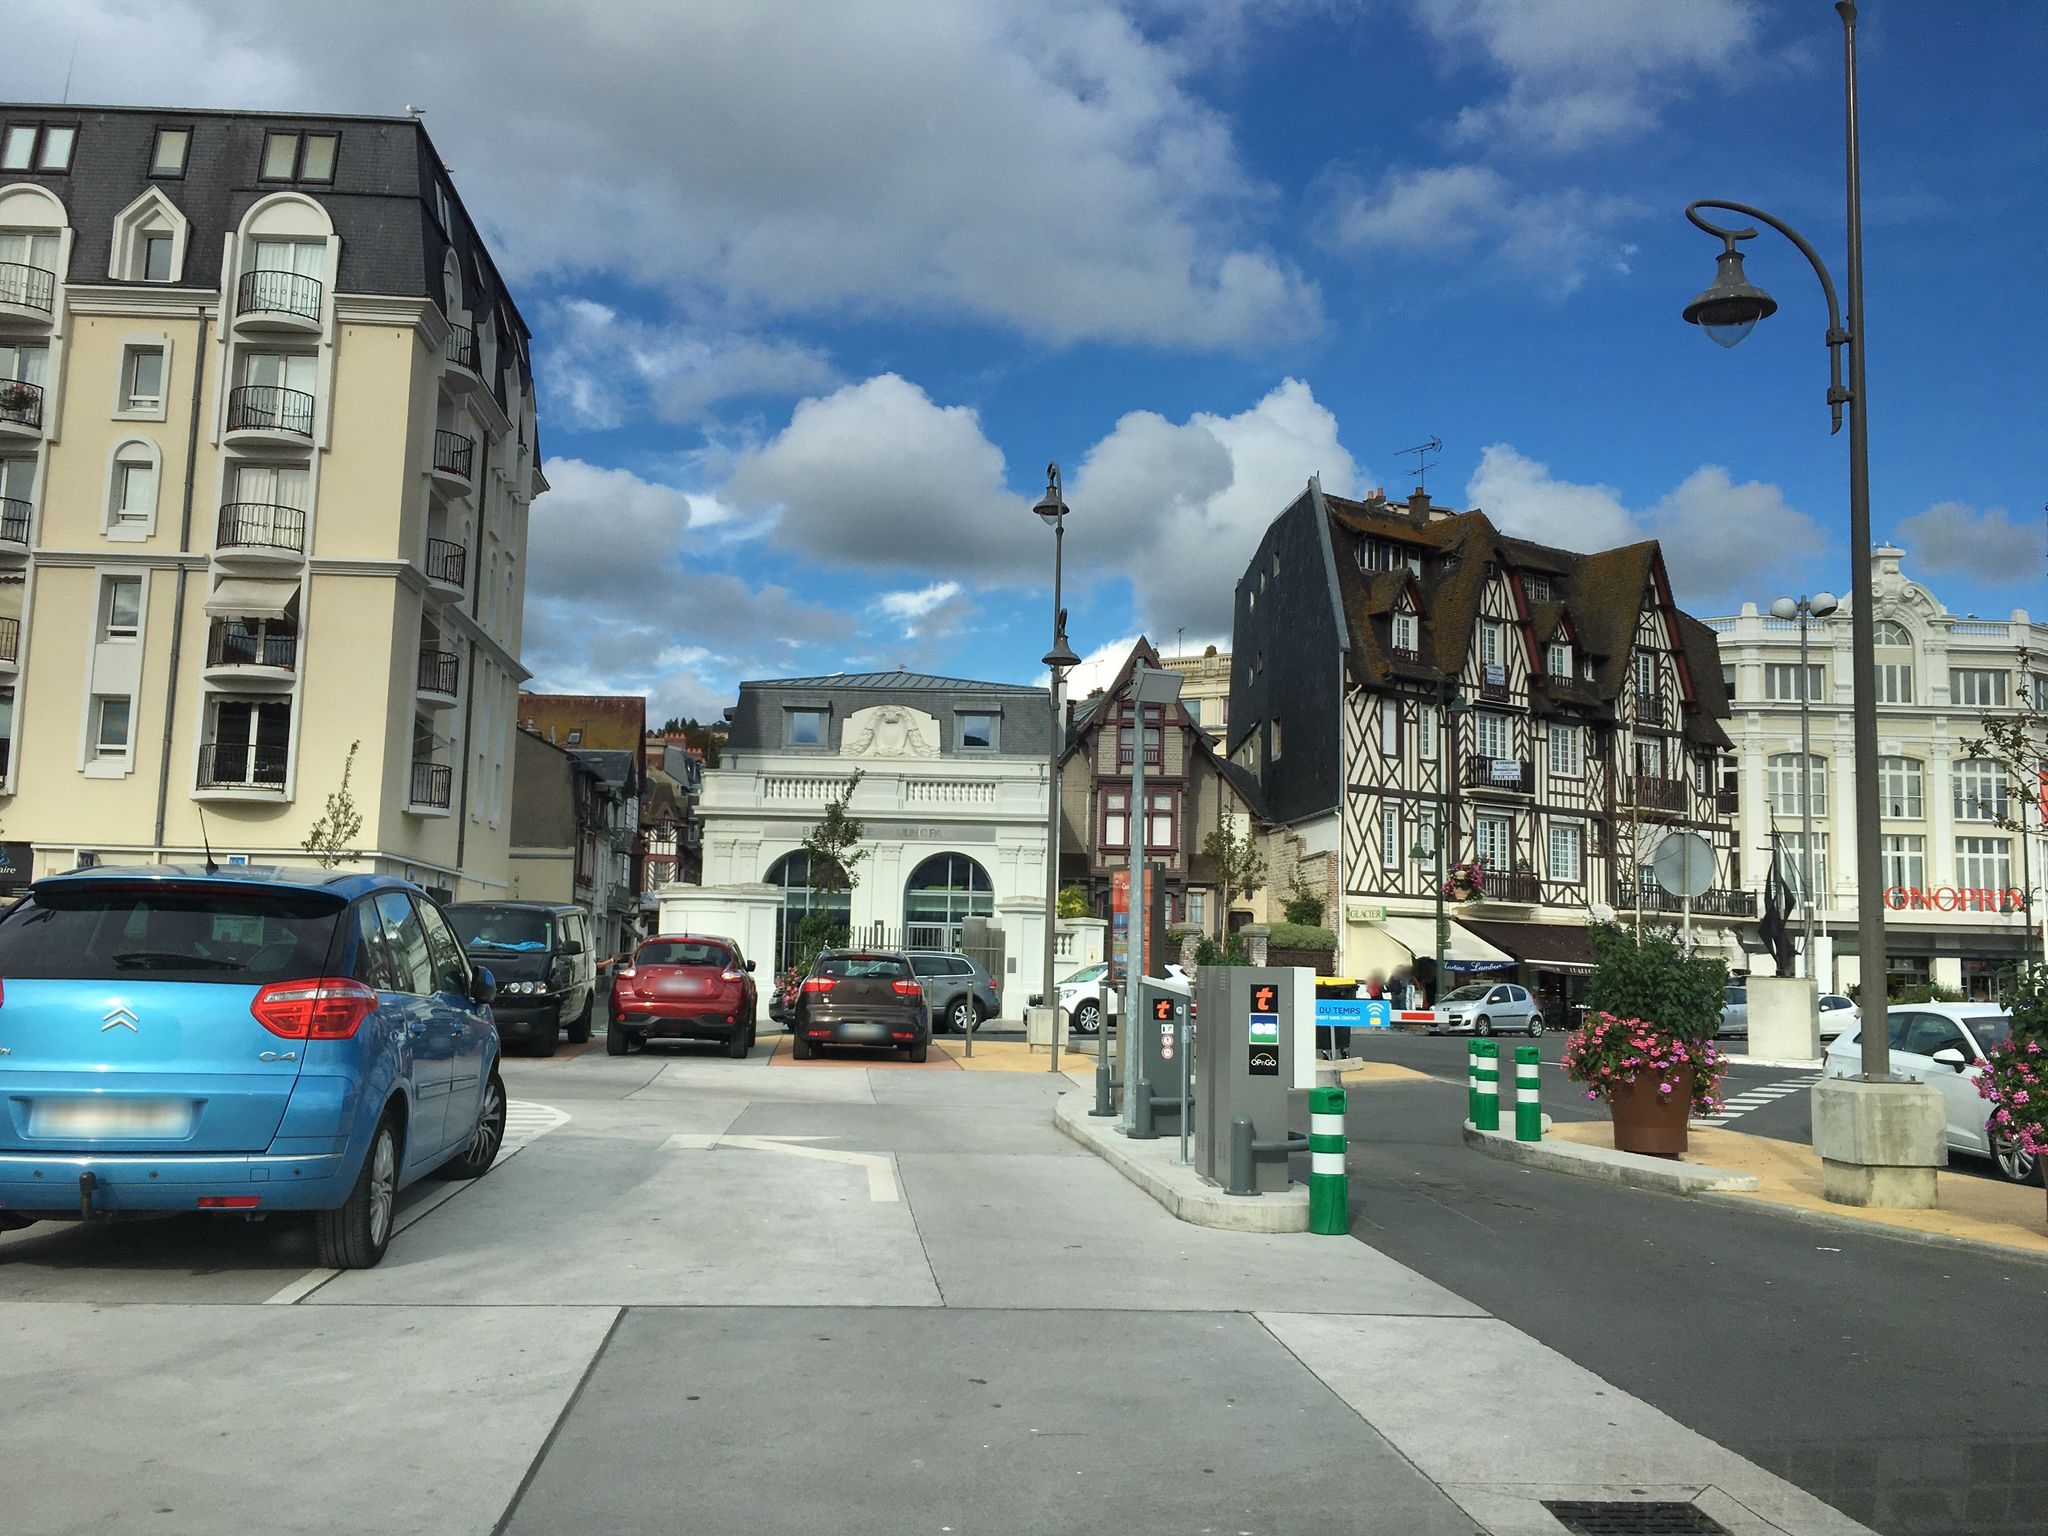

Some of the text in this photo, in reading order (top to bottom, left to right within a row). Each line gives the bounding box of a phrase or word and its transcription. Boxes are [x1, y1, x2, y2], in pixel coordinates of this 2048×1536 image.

[1884, 884, 2028, 912] ONOPRIX
[1350, 909, 1381, 918] GLACIER
[259, 1051, 297, 1062] C4
